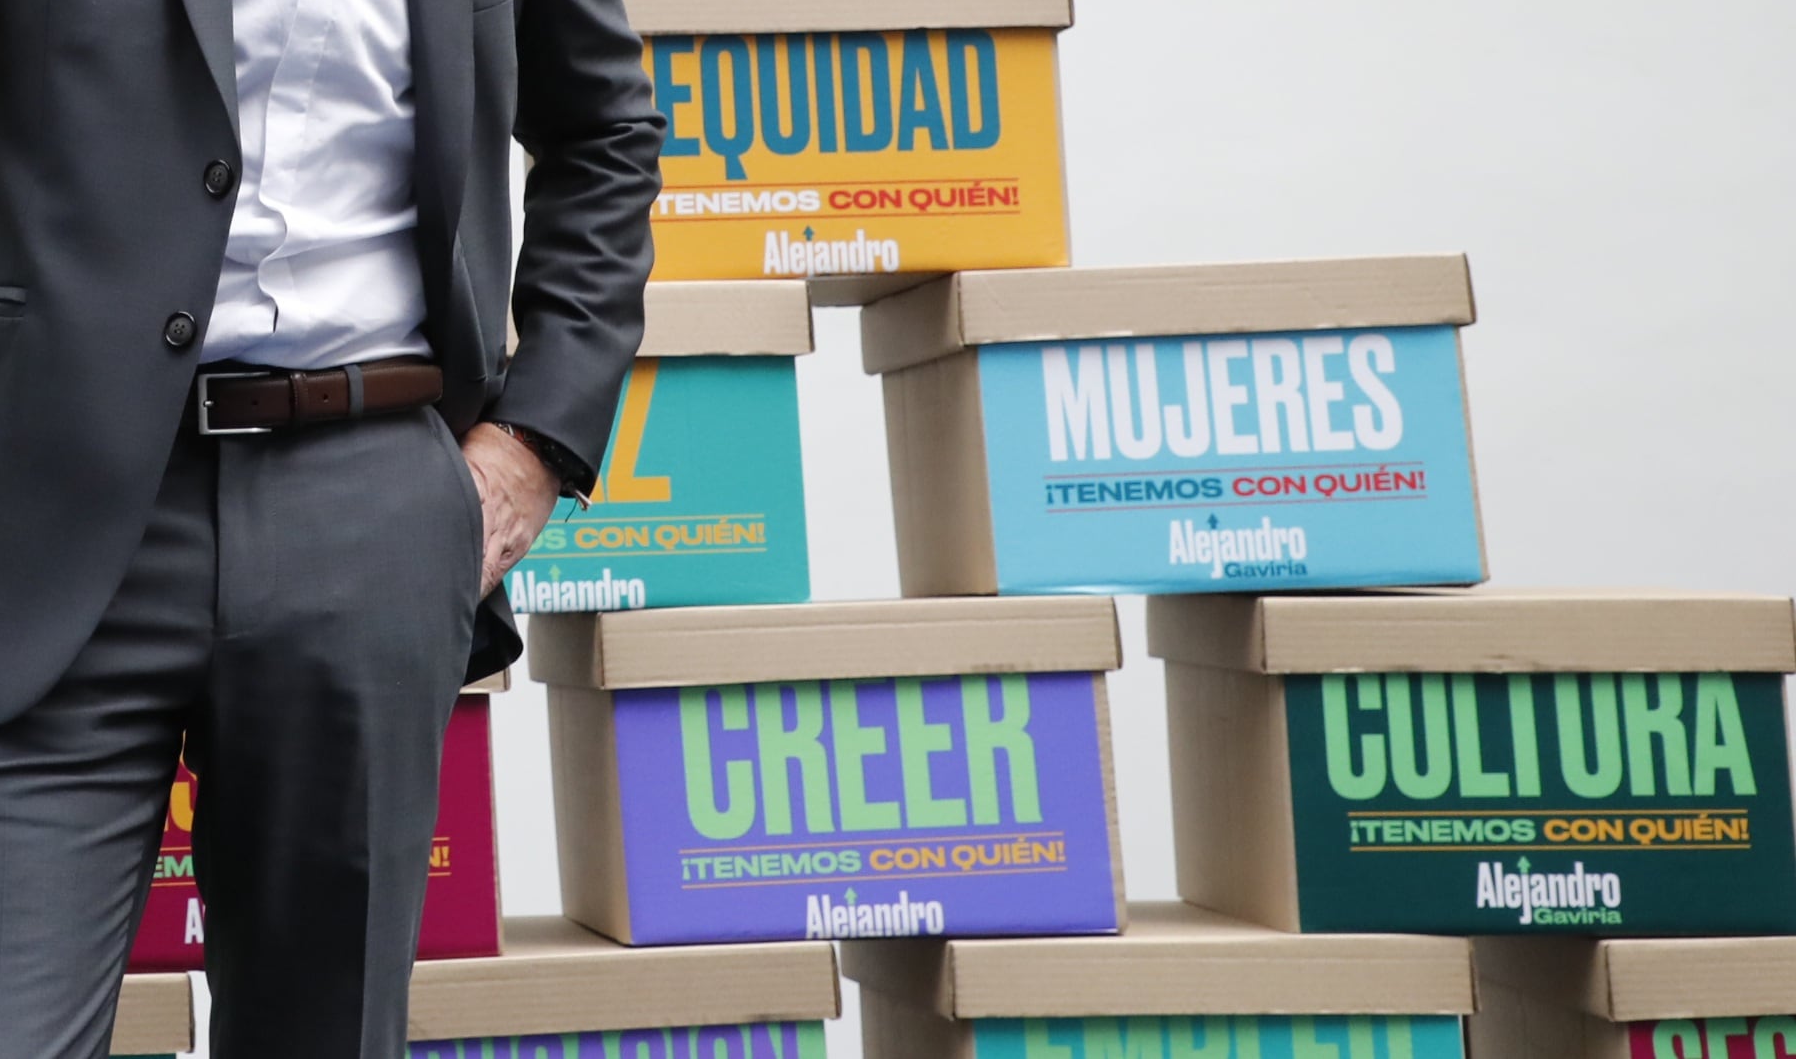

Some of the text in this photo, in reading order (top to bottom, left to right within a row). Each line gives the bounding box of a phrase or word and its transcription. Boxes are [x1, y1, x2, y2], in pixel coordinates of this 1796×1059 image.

[652, 29, 1001, 181] EQUIDAD
[650, 182, 1019, 215] TENEMOS CON QUIÉN!
[1042, 334, 1403, 461] MUJERES
[1046, 467, 1425, 505] ¡TENEMOS CON QUIÉN!
[575, 523, 649, 549] CON
[656, 517, 766, 550] QUIÉN!
[1169, 517, 1307, 579] Alejandro
[1224, 561, 1307, 580] Gaviria
[679, 674, 1043, 840] CREER
[1322, 673, 1757, 800] CULTURA
[1351, 814, 1748, 845] ¡TENEMOS CON QUIÉN!
[681, 838, 1065, 881] ¡TENEMOS CON QUIÉN!
[1477, 861, 1620, 925] Alejandro
[1534, 908, 1621, 925] Gaviria
